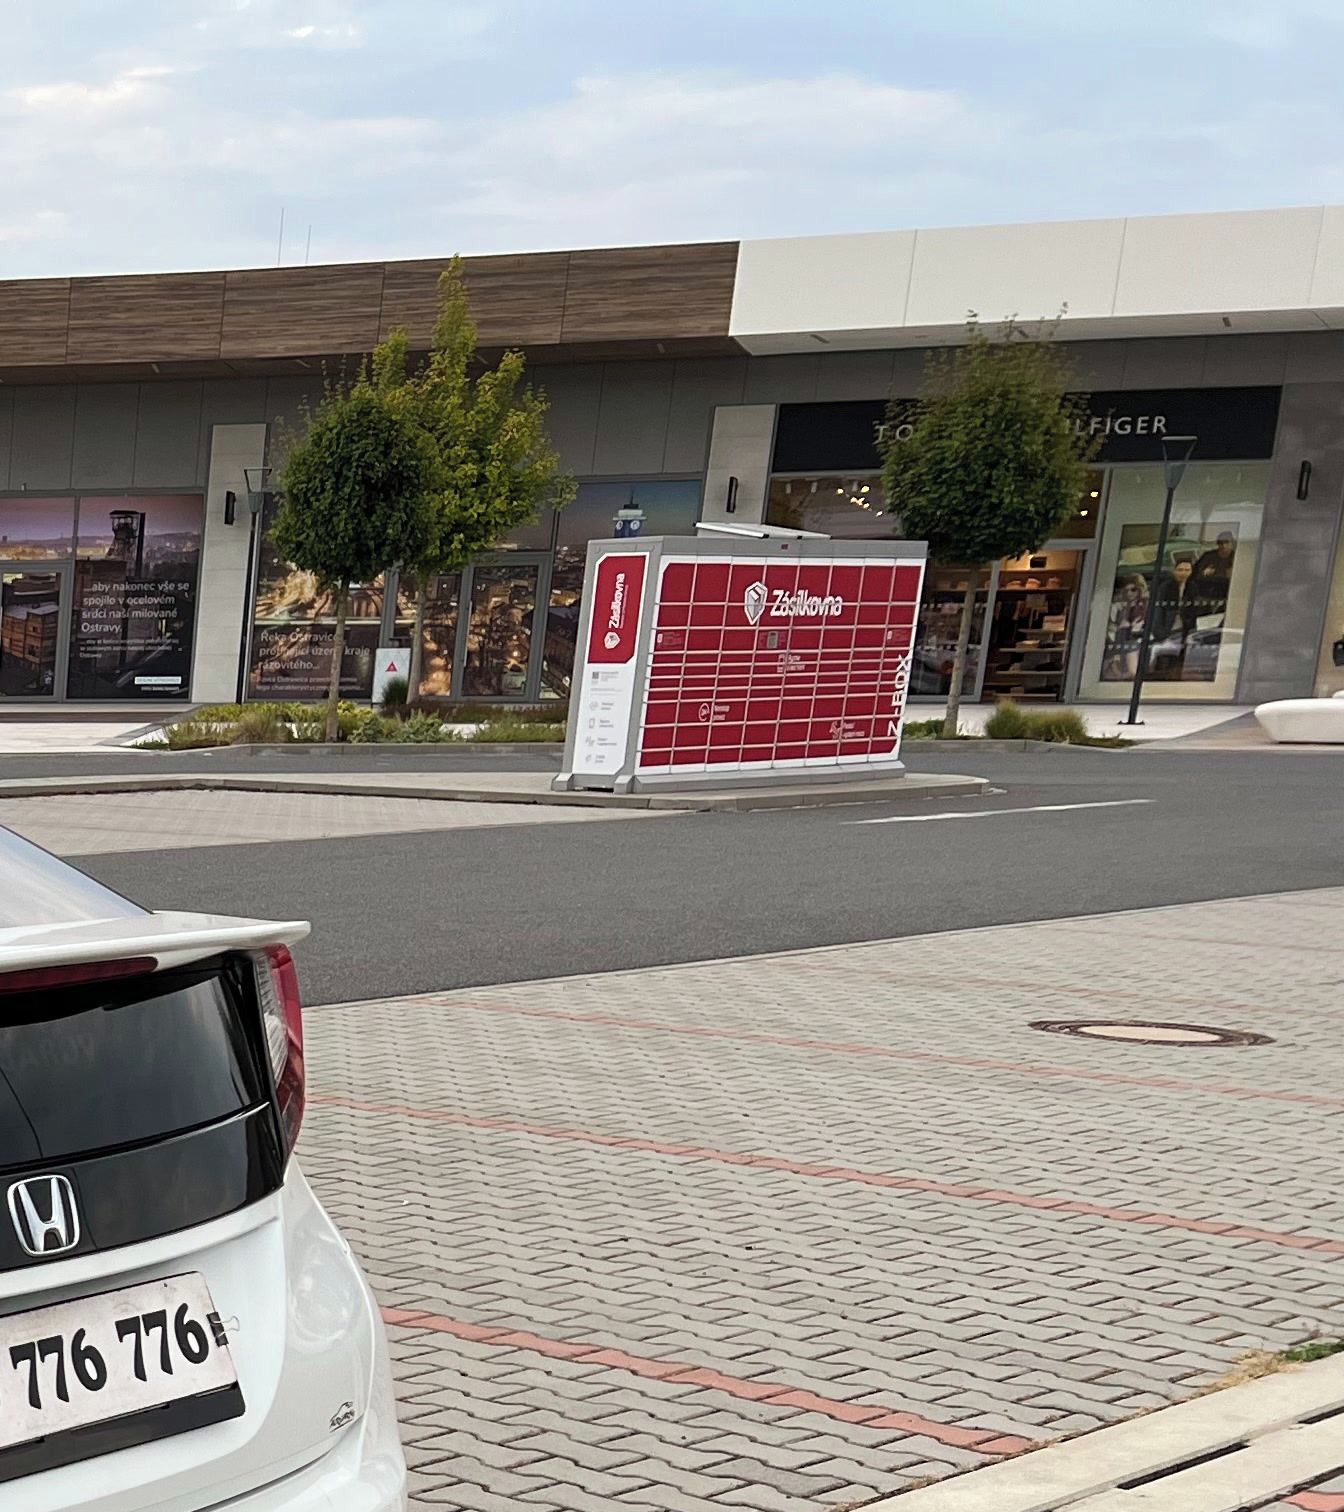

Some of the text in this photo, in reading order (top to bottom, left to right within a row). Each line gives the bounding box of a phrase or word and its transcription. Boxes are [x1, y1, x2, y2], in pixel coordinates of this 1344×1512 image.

[1064, 416, 1167, 436] ILFIGER
[770, 589, 843, 617] Zásilkovna
[9, 1327, 107, 1410] 776
[115, 1302, 210, 1383] 776
